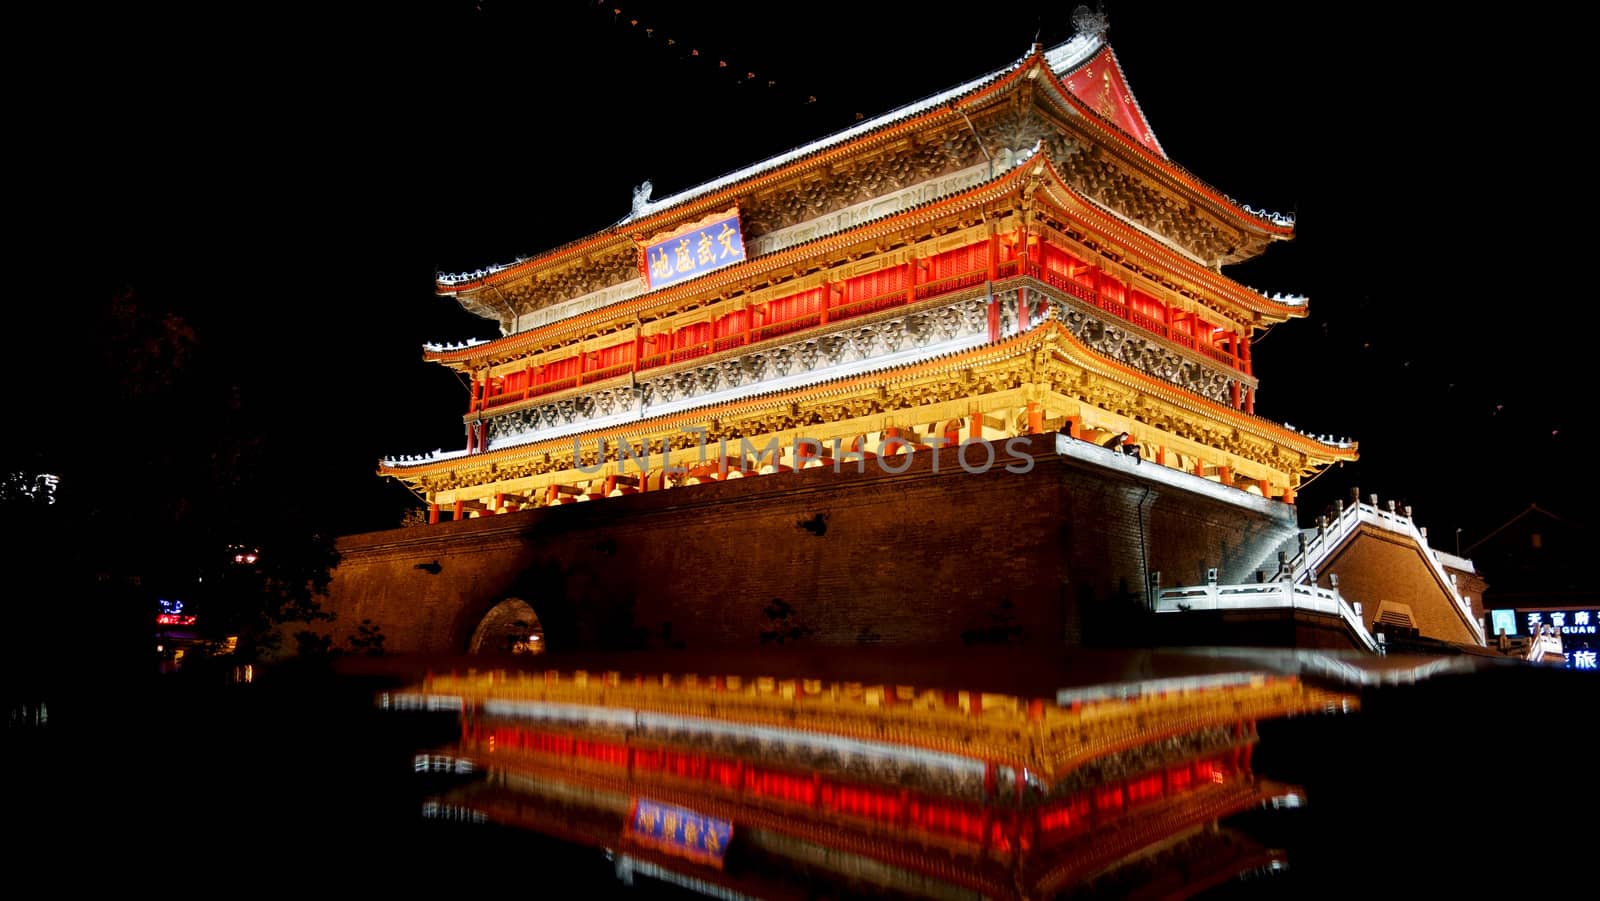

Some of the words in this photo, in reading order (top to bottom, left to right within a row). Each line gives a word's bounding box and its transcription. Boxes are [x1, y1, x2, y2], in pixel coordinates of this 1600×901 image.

[1527, 611, 1600, 626] 天官府
[1562, 626, 1596, 634] GUAN
